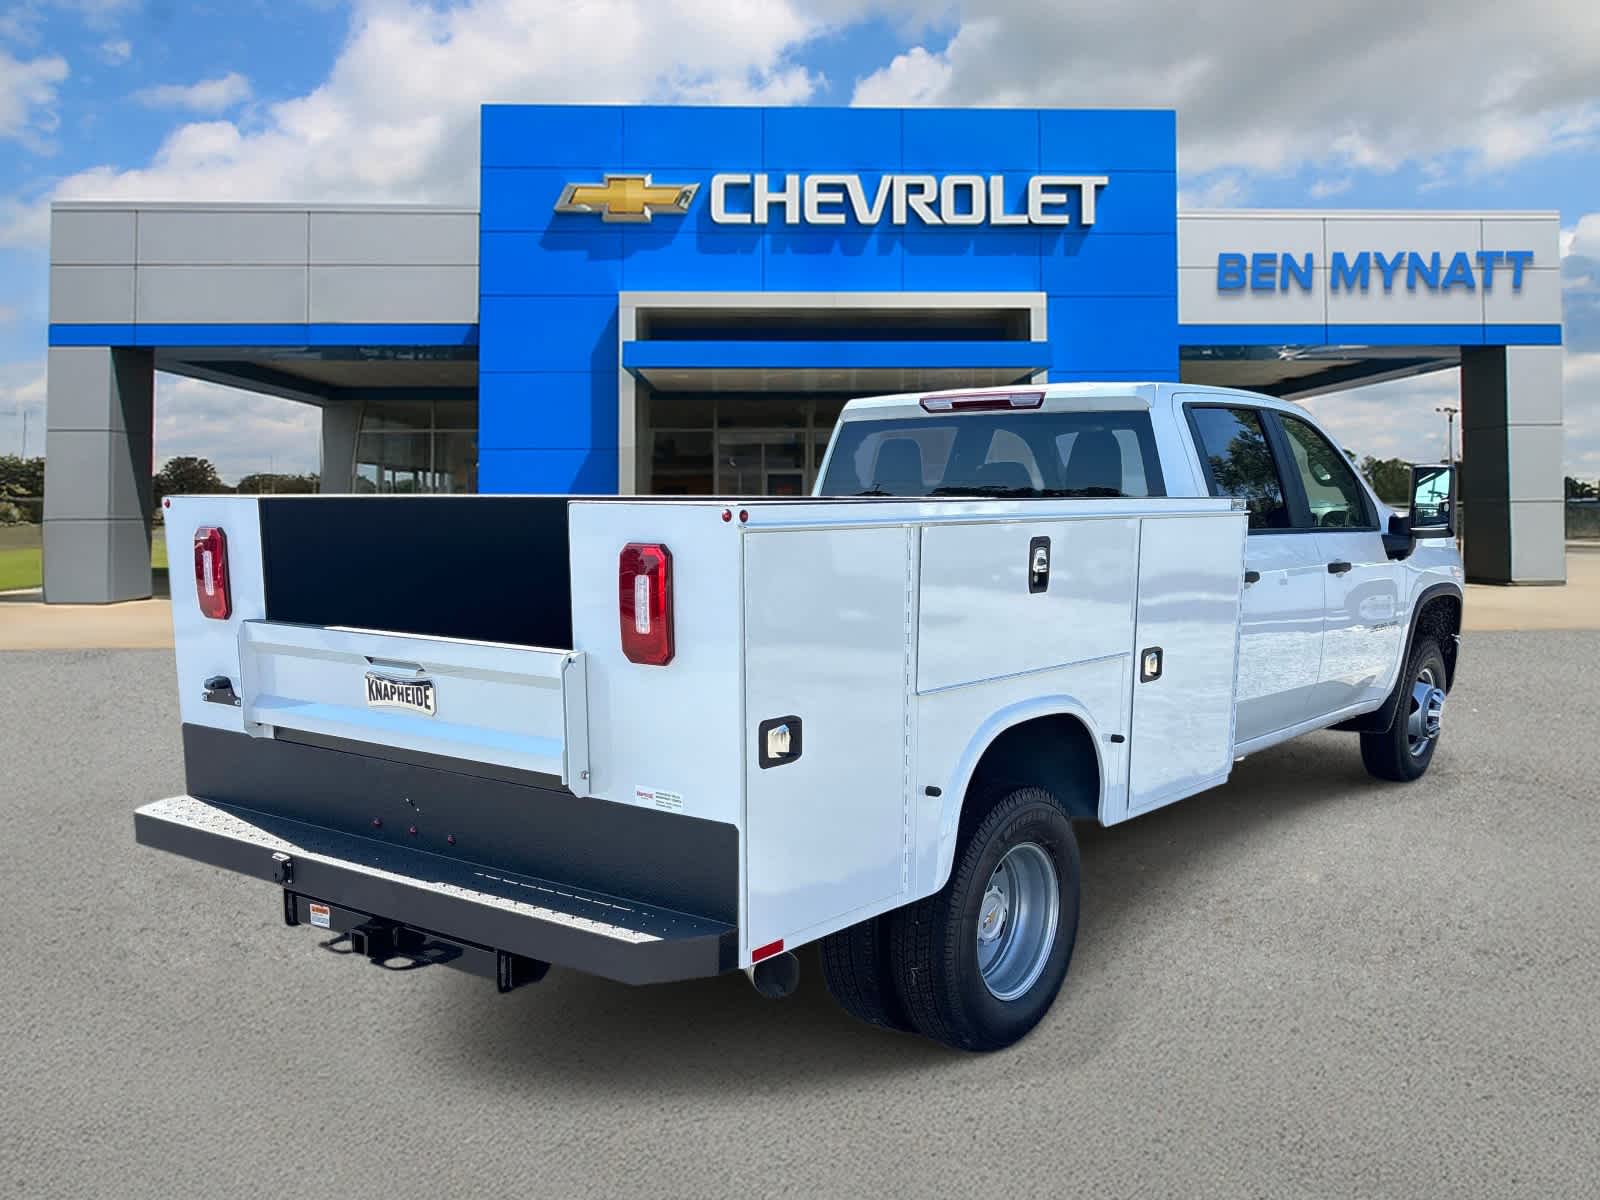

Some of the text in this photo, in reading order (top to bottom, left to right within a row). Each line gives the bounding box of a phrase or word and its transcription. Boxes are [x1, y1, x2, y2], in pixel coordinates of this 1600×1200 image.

[709, 173, 1109, 226] CHEVROLET
[1217, 250, 1535, 291] BEN MYNATT
[367, 677, 432, 711] KNAPHEIDE
